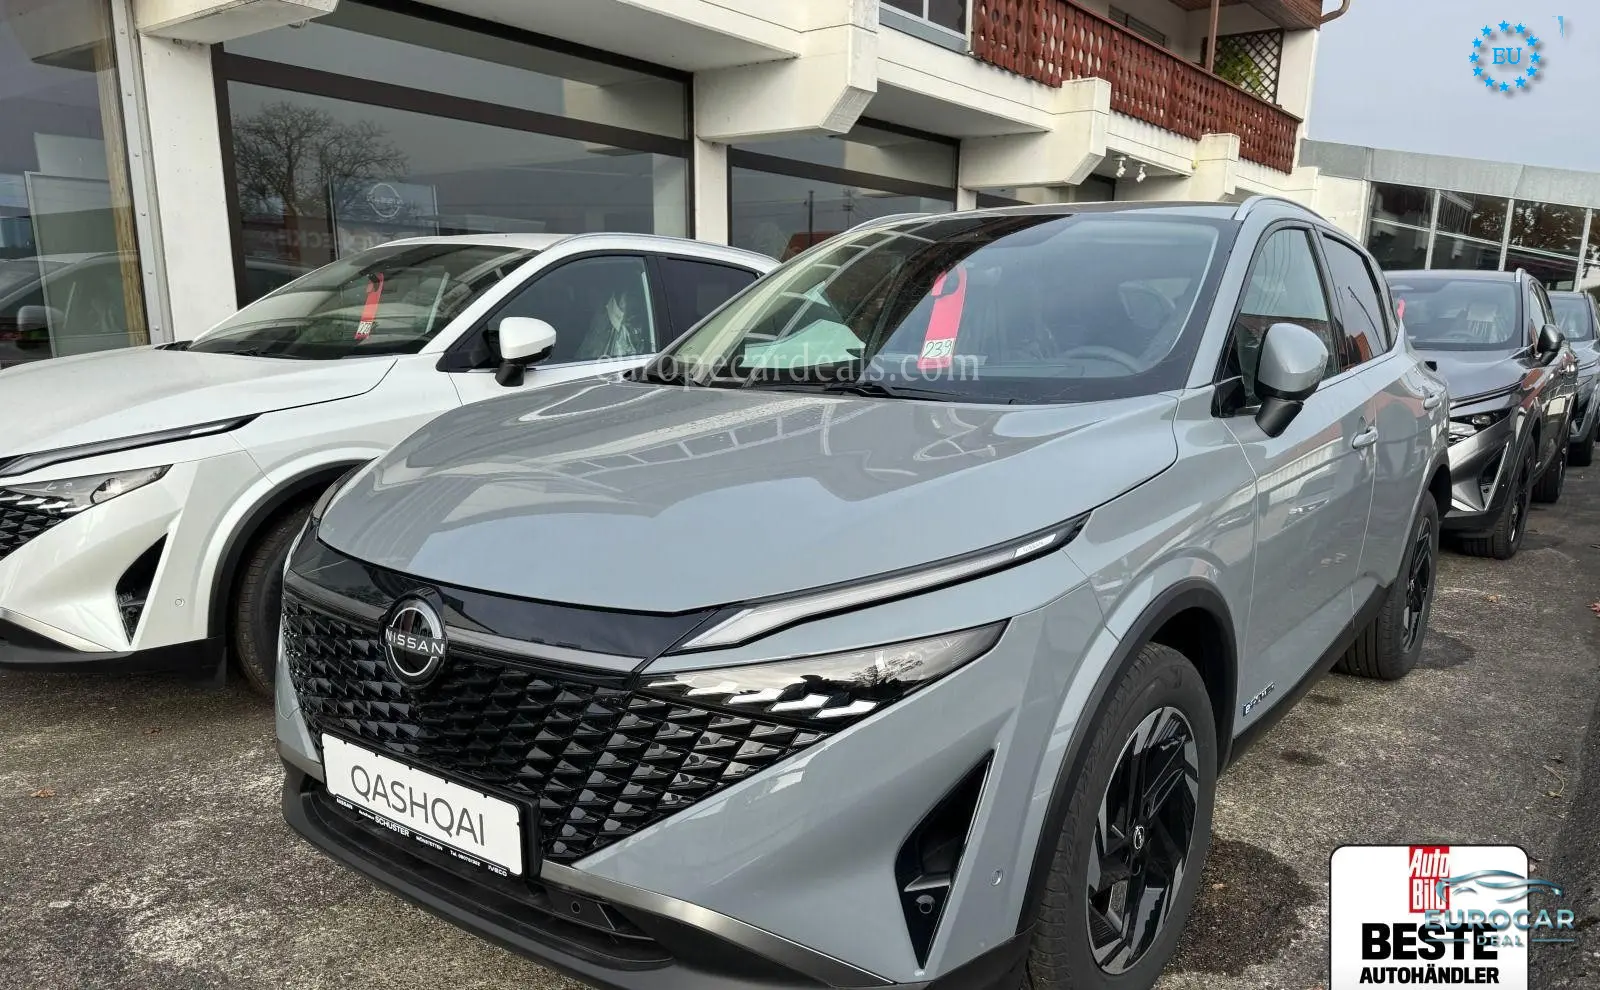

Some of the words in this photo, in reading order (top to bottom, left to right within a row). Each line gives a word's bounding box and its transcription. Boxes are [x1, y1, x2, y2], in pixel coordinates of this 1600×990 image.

[922, 340, 952, 358] 239
[386, 629, 444, 654] NISSAN
[351, 765, 485, 846] QASHQAI
[375, 815, 410, 837] SCHUSTER
